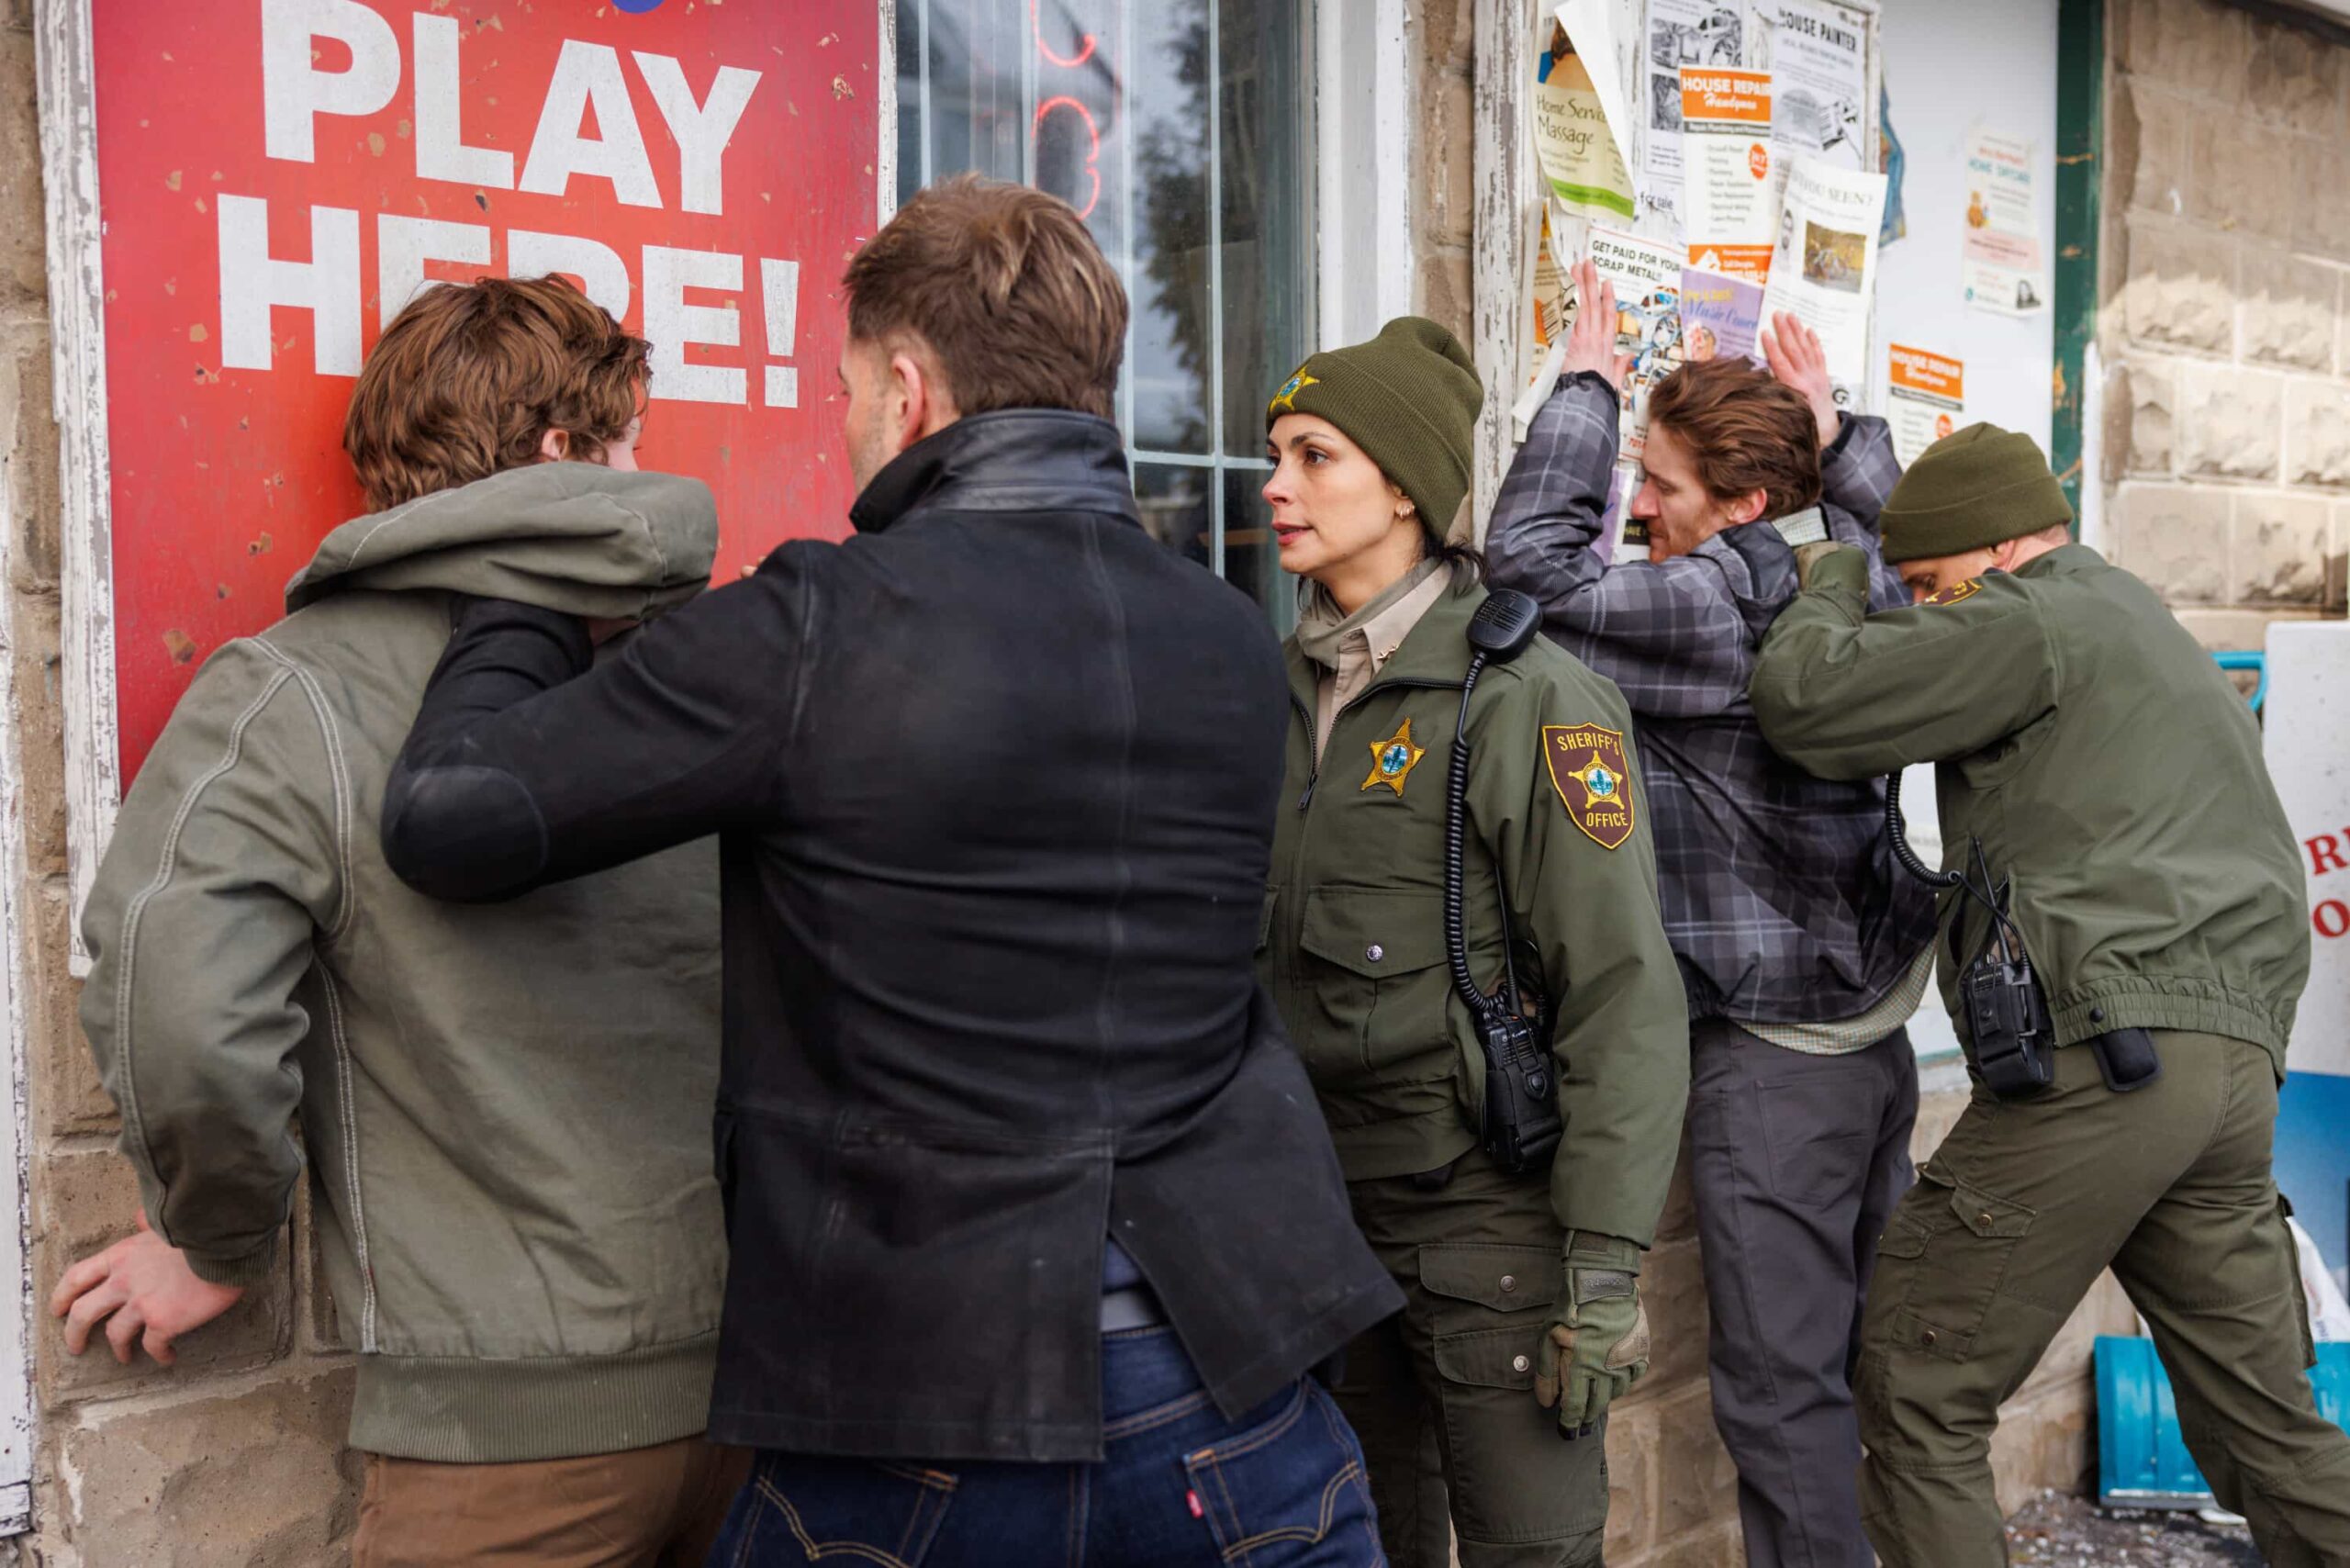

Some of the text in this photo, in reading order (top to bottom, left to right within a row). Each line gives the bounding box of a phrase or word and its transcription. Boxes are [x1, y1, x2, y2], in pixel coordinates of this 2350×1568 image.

[1683, 76, 1731, 93] HOUSE
[262, 0, 763, 215] PLAY
[1537, 94, 1607, 123] Home Servic
[1539, 115, 1595, 154] Massage
[1657, 196, 1674, 210] sale
[1592, 240, 1681, 273] GET PAID FOR YOUR
[1592, 255, 1624, 272] SCRAP
[1557, 733, 1619, 756] SHERIFF'S
[1586, 812, 1628, 827] OFFICE
[2304, 825, 2350, 877] R
